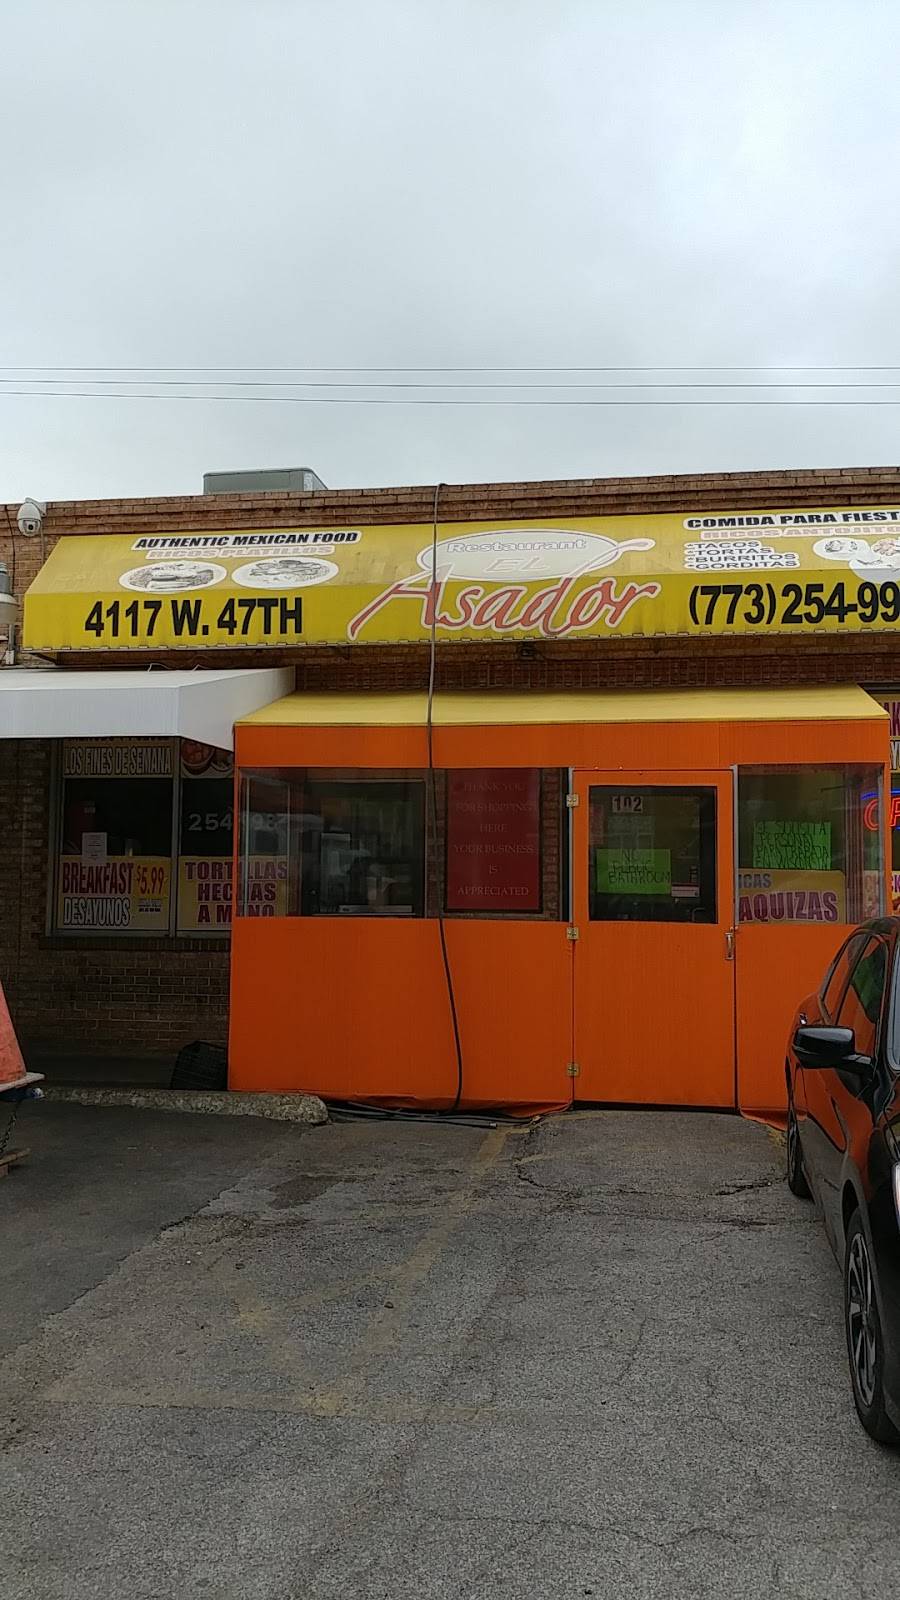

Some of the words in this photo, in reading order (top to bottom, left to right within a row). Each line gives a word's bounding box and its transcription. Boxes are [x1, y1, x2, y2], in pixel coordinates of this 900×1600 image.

[687, 515, 775, 528] COMIDA
[781, 513, 837, 525] PARA
[135, 535, 230, 549] AUTHENTIC
[231, 534, 311, 547] MEXICAN
[312, 532, 358, 544] FOOD
[446, 538, 588, 554] Restaurant
[694, 541, 760, 549] TACOS
[694, 547, 774, 556] TORTAS
[694, 553, 796, 563] BURRITOS
[695, 560, 798, 570] GORDITAS
[347, 550, 661, 640] Asador
[85, 600, 163, 637] 4117
[171, 599, 210, 637] W.
[217, 597, 303, 635] 47TH
[64, 747, 83, 776] LOS
[85, 746, 113, 776] FINES
[115, 745, 129, 776] DE
[129, 745, 172, 776] SEMANA
[62, 862, 134, 894] BREAKFAST
[136, 864, 165, 895] $5.99
[457, 886, 530, 896] APPRECIATED
[63, 896, 131, 927] DESAYUNOS
[197, 904, 211, 923] A
